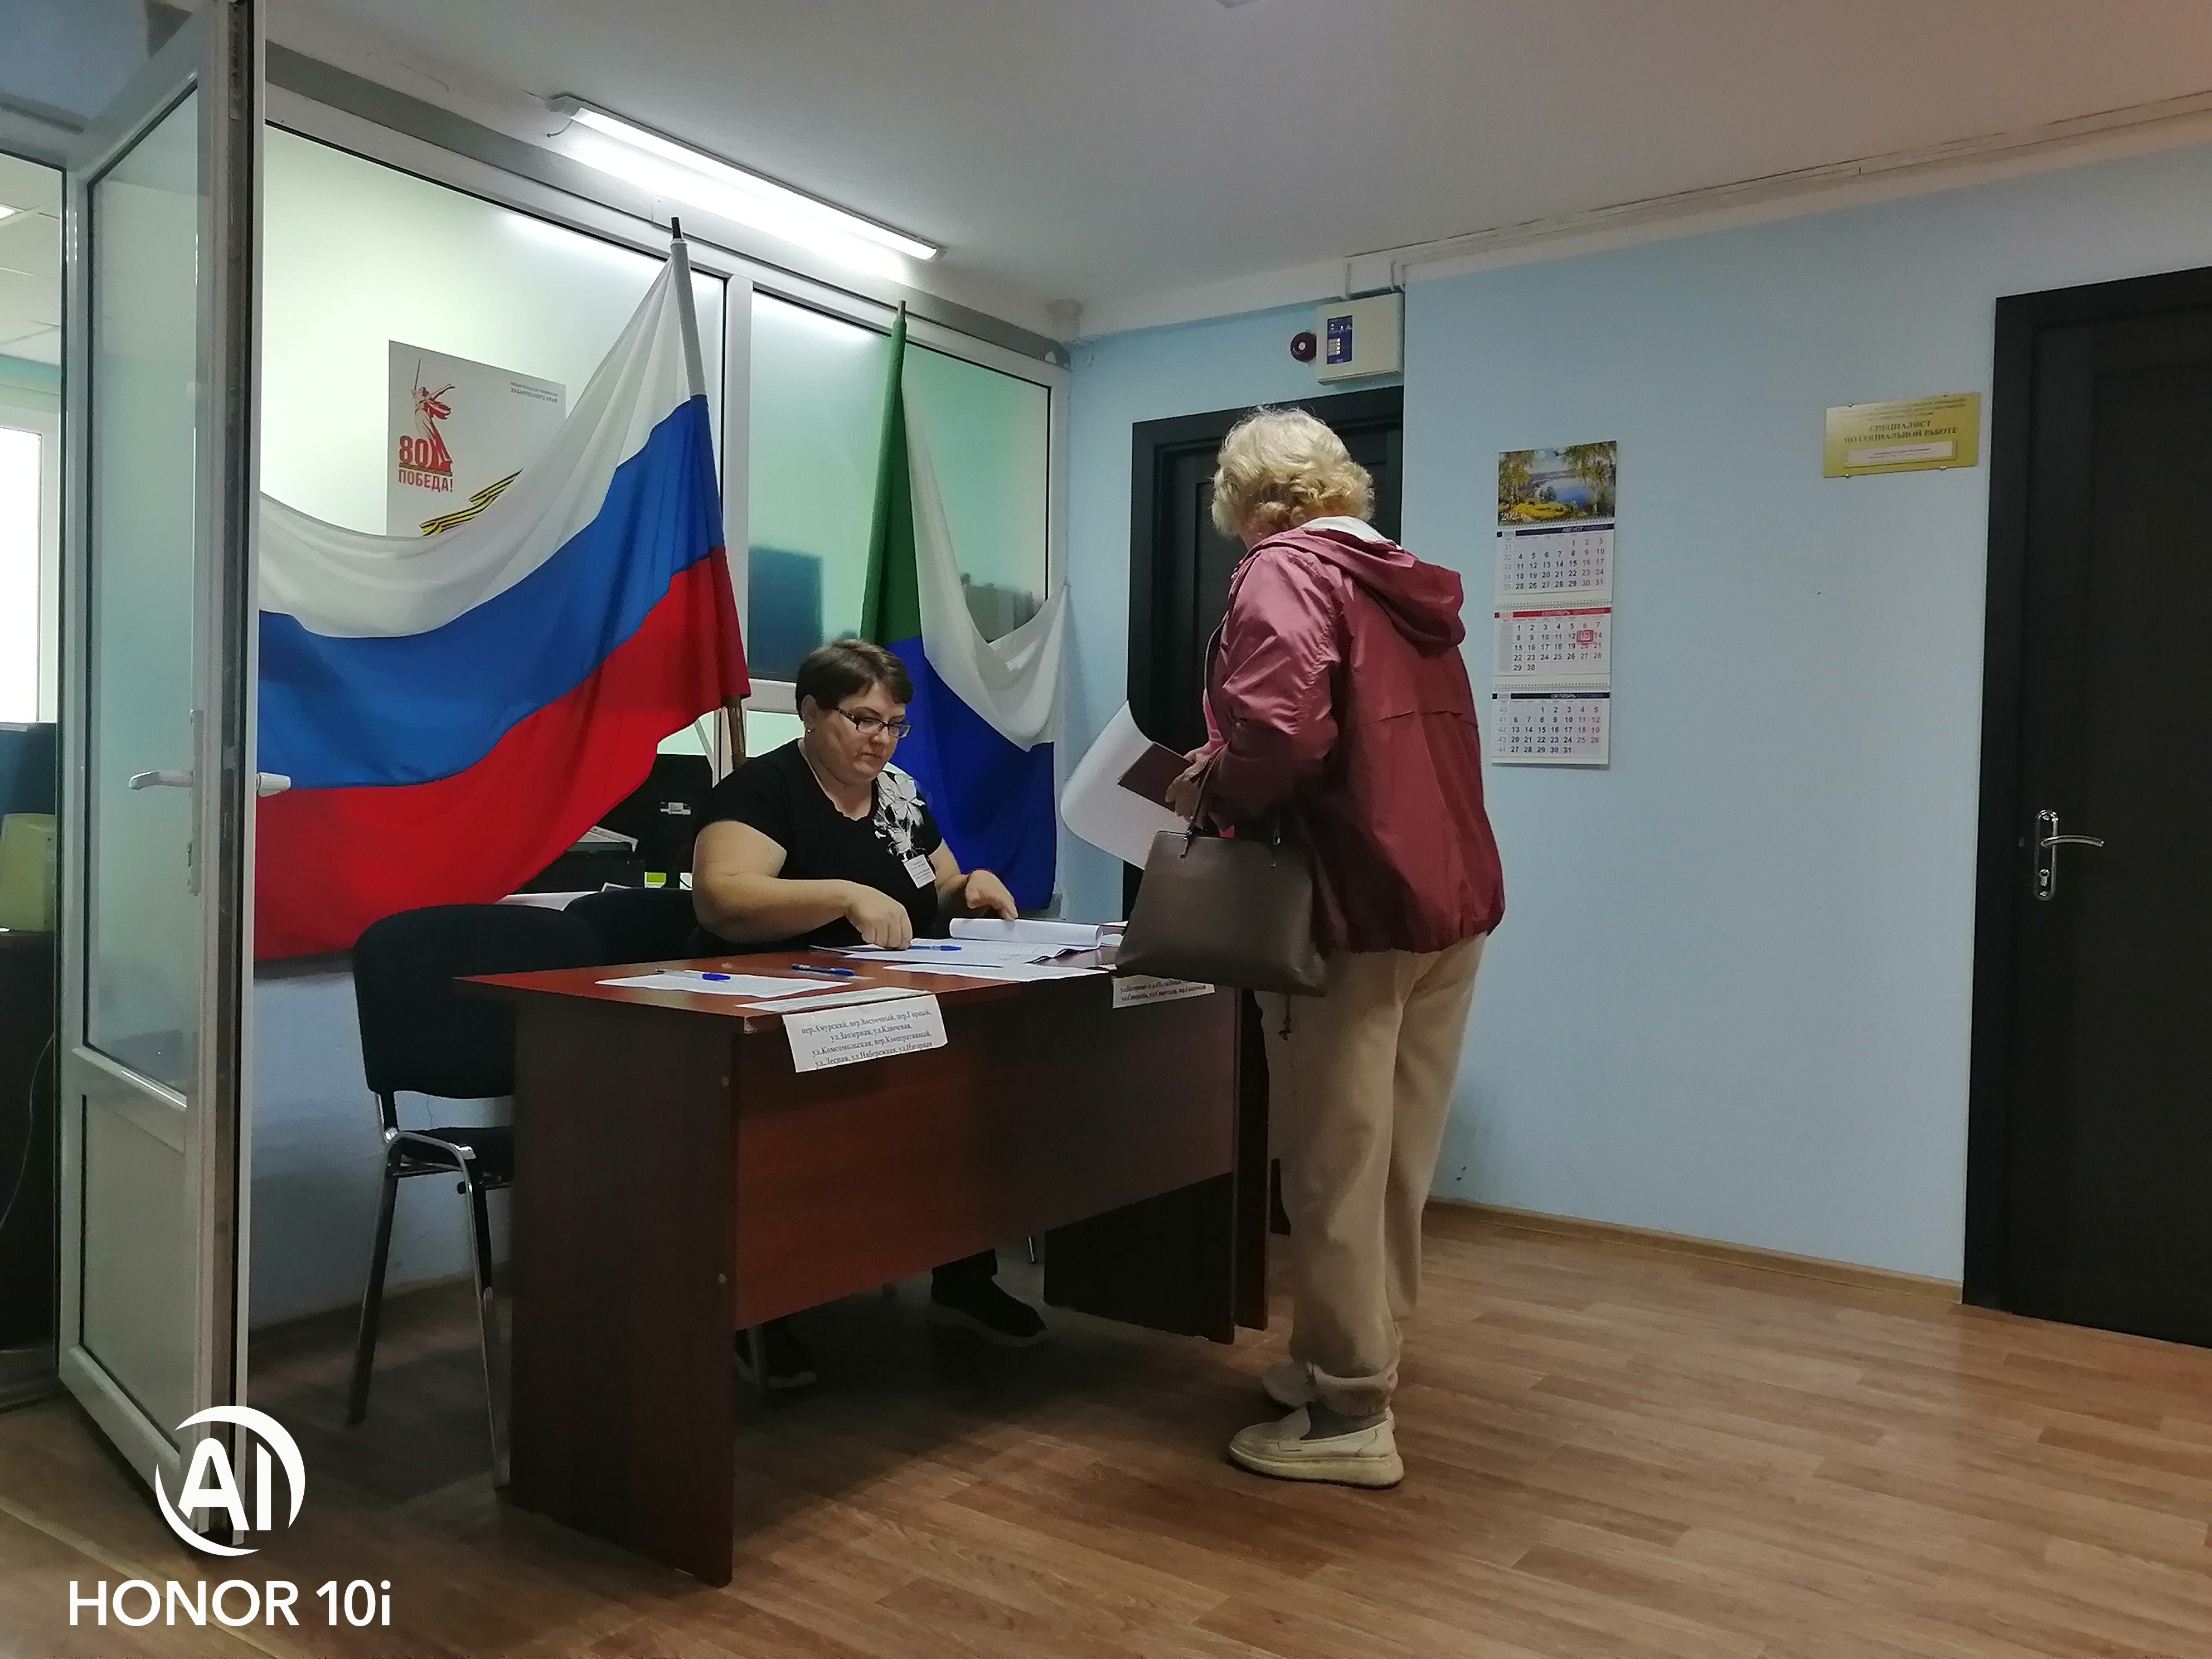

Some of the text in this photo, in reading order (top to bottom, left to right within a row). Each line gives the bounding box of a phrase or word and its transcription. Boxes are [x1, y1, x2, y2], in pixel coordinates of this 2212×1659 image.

[1859, 429, 1922, 442] СОЦИАЛЬНОЙ
[1924, 426, 1957, 437] РАБОТЕ
[1870, 420, 1930, 431] СПЕЦИАЛИСТ
[399, 435, 429, 468] 80
[398, 469, 453, 493] ПОБЕДА!
